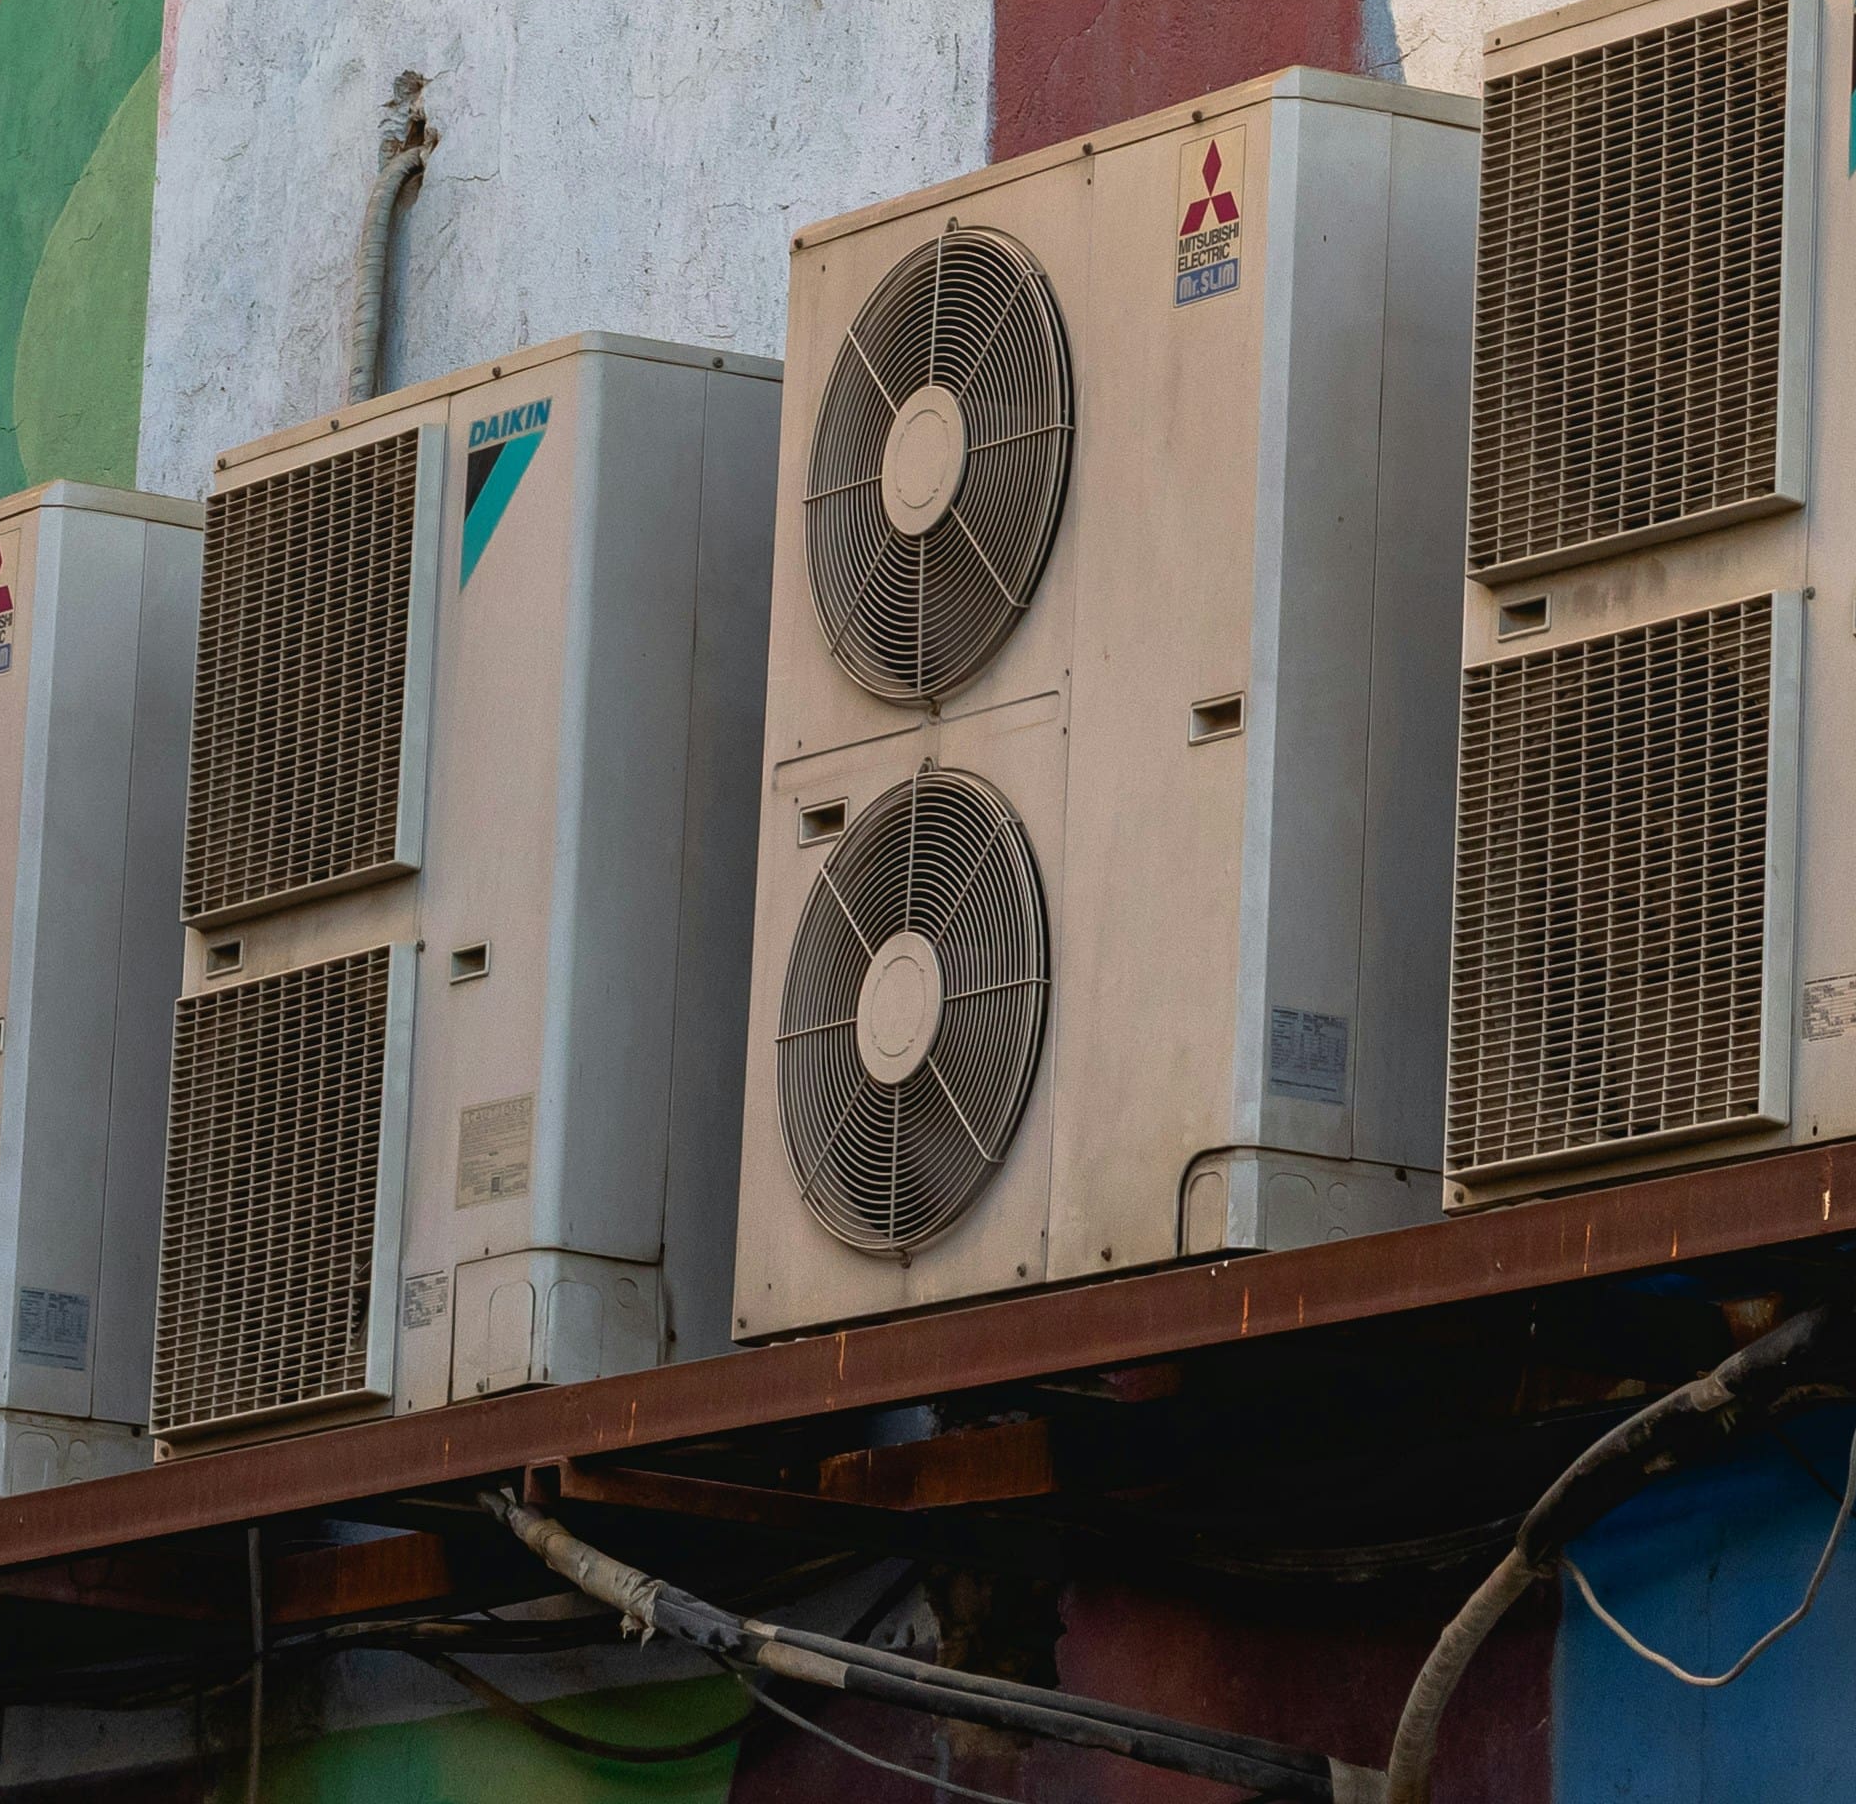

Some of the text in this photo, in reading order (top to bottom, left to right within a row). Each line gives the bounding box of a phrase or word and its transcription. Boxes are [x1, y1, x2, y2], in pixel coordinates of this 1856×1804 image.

[1178, 221, 1240, 256] MITSUBISHI
[1177, 242, 1231, 274] ELECTRIC
[467, 397, 553, 449] DAIKIN
